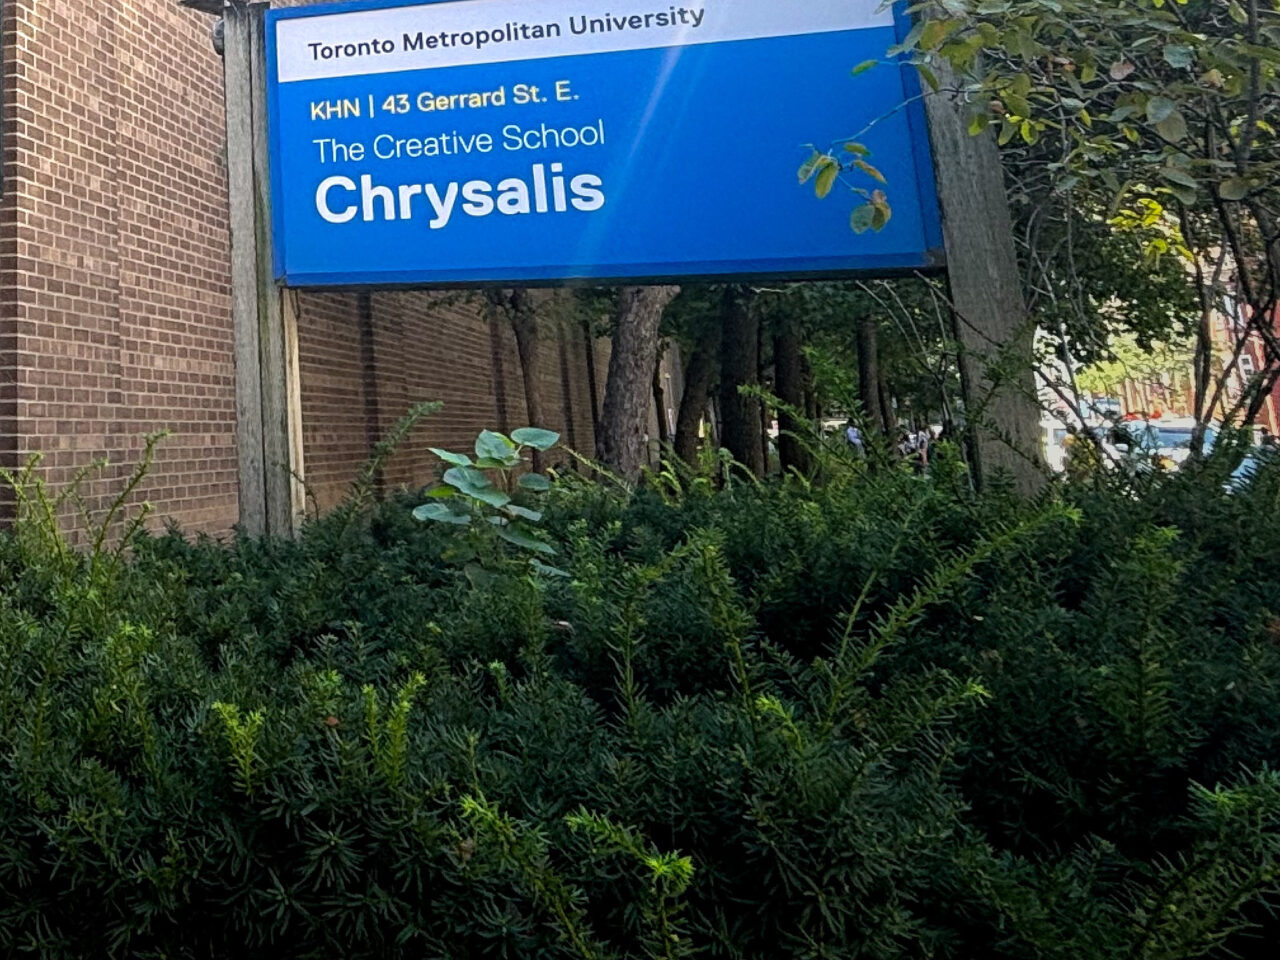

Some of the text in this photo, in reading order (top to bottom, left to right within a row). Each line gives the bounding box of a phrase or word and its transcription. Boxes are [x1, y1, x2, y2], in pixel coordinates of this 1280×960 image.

[307, 6, 706, 61] Toronto Metropolitan University
[310, 96, 361, 121] KHN
[381, 92, 411, 115] 43
[417, 84, 506, 113] Gerrard
[513, 82, 548, 104] St.
[555, 79, 580, 102] E.
[312, 118, 605, 164] The Creative School
[315, 162, 605, 230] Chrysalis
